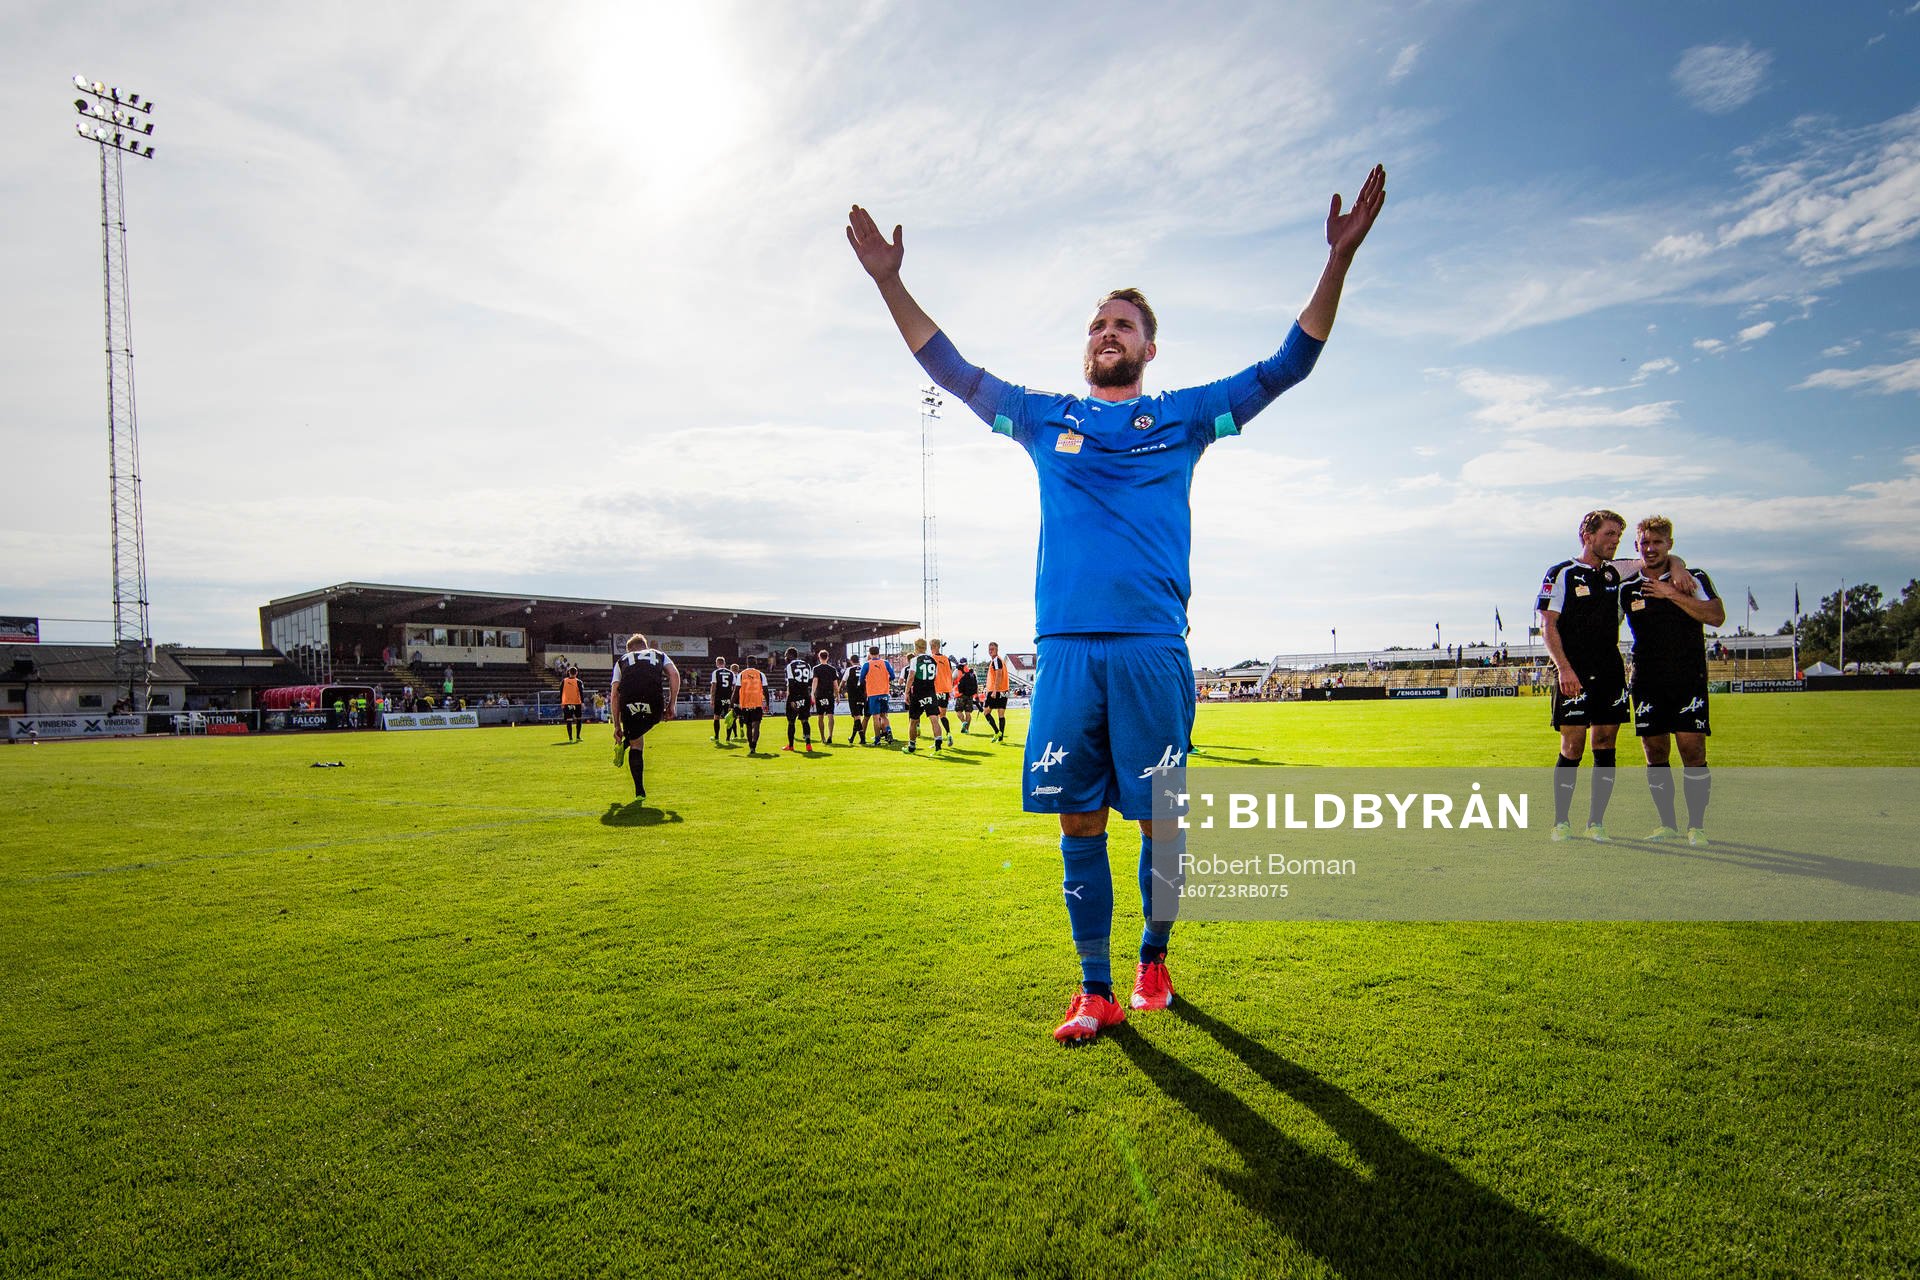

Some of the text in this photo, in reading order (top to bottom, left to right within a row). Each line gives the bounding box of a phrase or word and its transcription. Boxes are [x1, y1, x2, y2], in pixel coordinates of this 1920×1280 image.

[622, 651, 659, 666] 14
[920, 663, 936, 680] 19
[722, 675, 729, 687] 5
[37, 720, 78, 728] VINBERGS
[292, 716, 327, 724] FALCON
